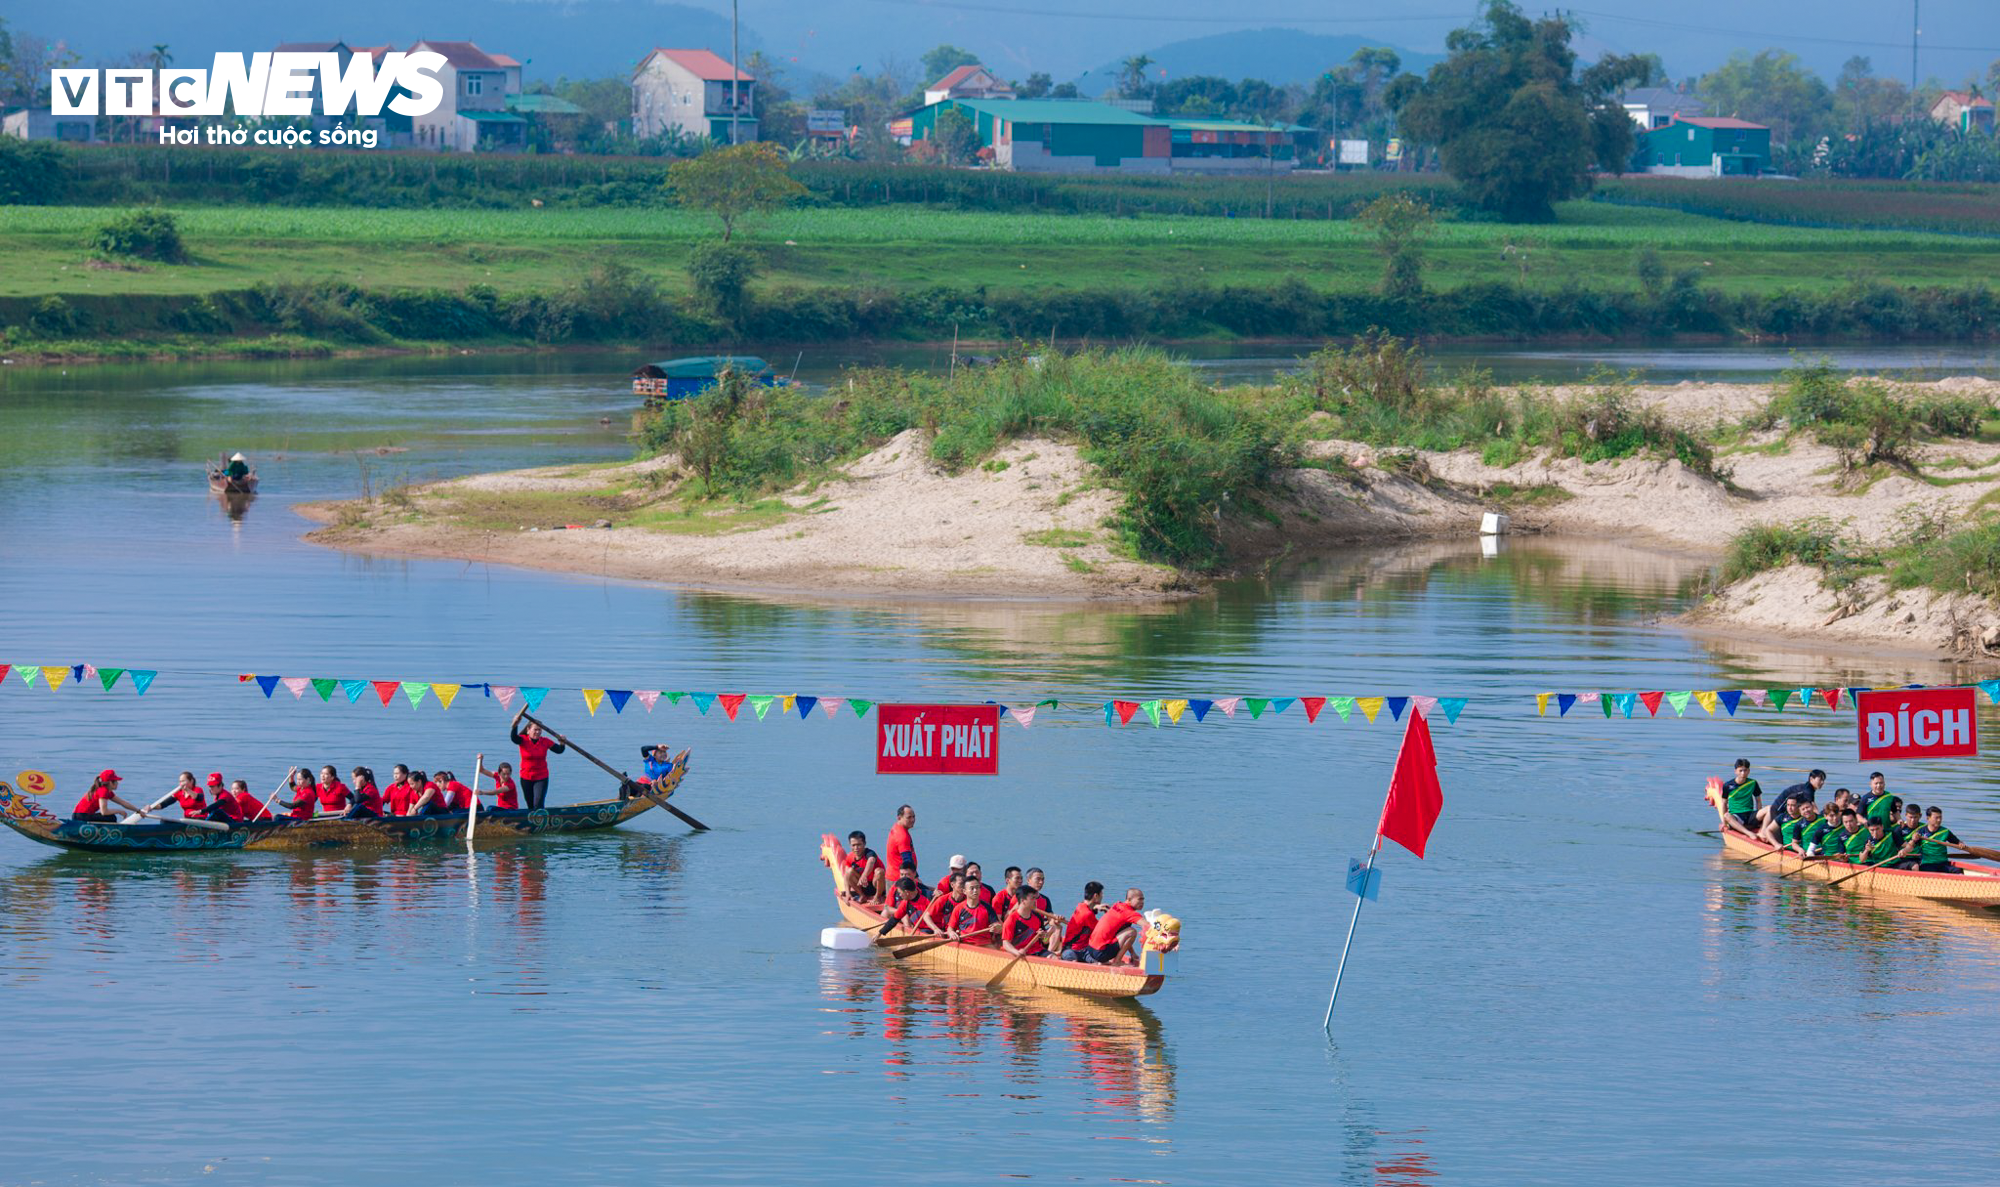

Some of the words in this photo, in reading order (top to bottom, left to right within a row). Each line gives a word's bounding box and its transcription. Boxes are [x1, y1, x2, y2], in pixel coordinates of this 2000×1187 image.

[882, 712, 936, 758] XUẤT
[941, 718, 994, 758] PHÁT
[1866, 703, 1970, 749] ĐÍCH
[28, 774, 45, 791] 2
